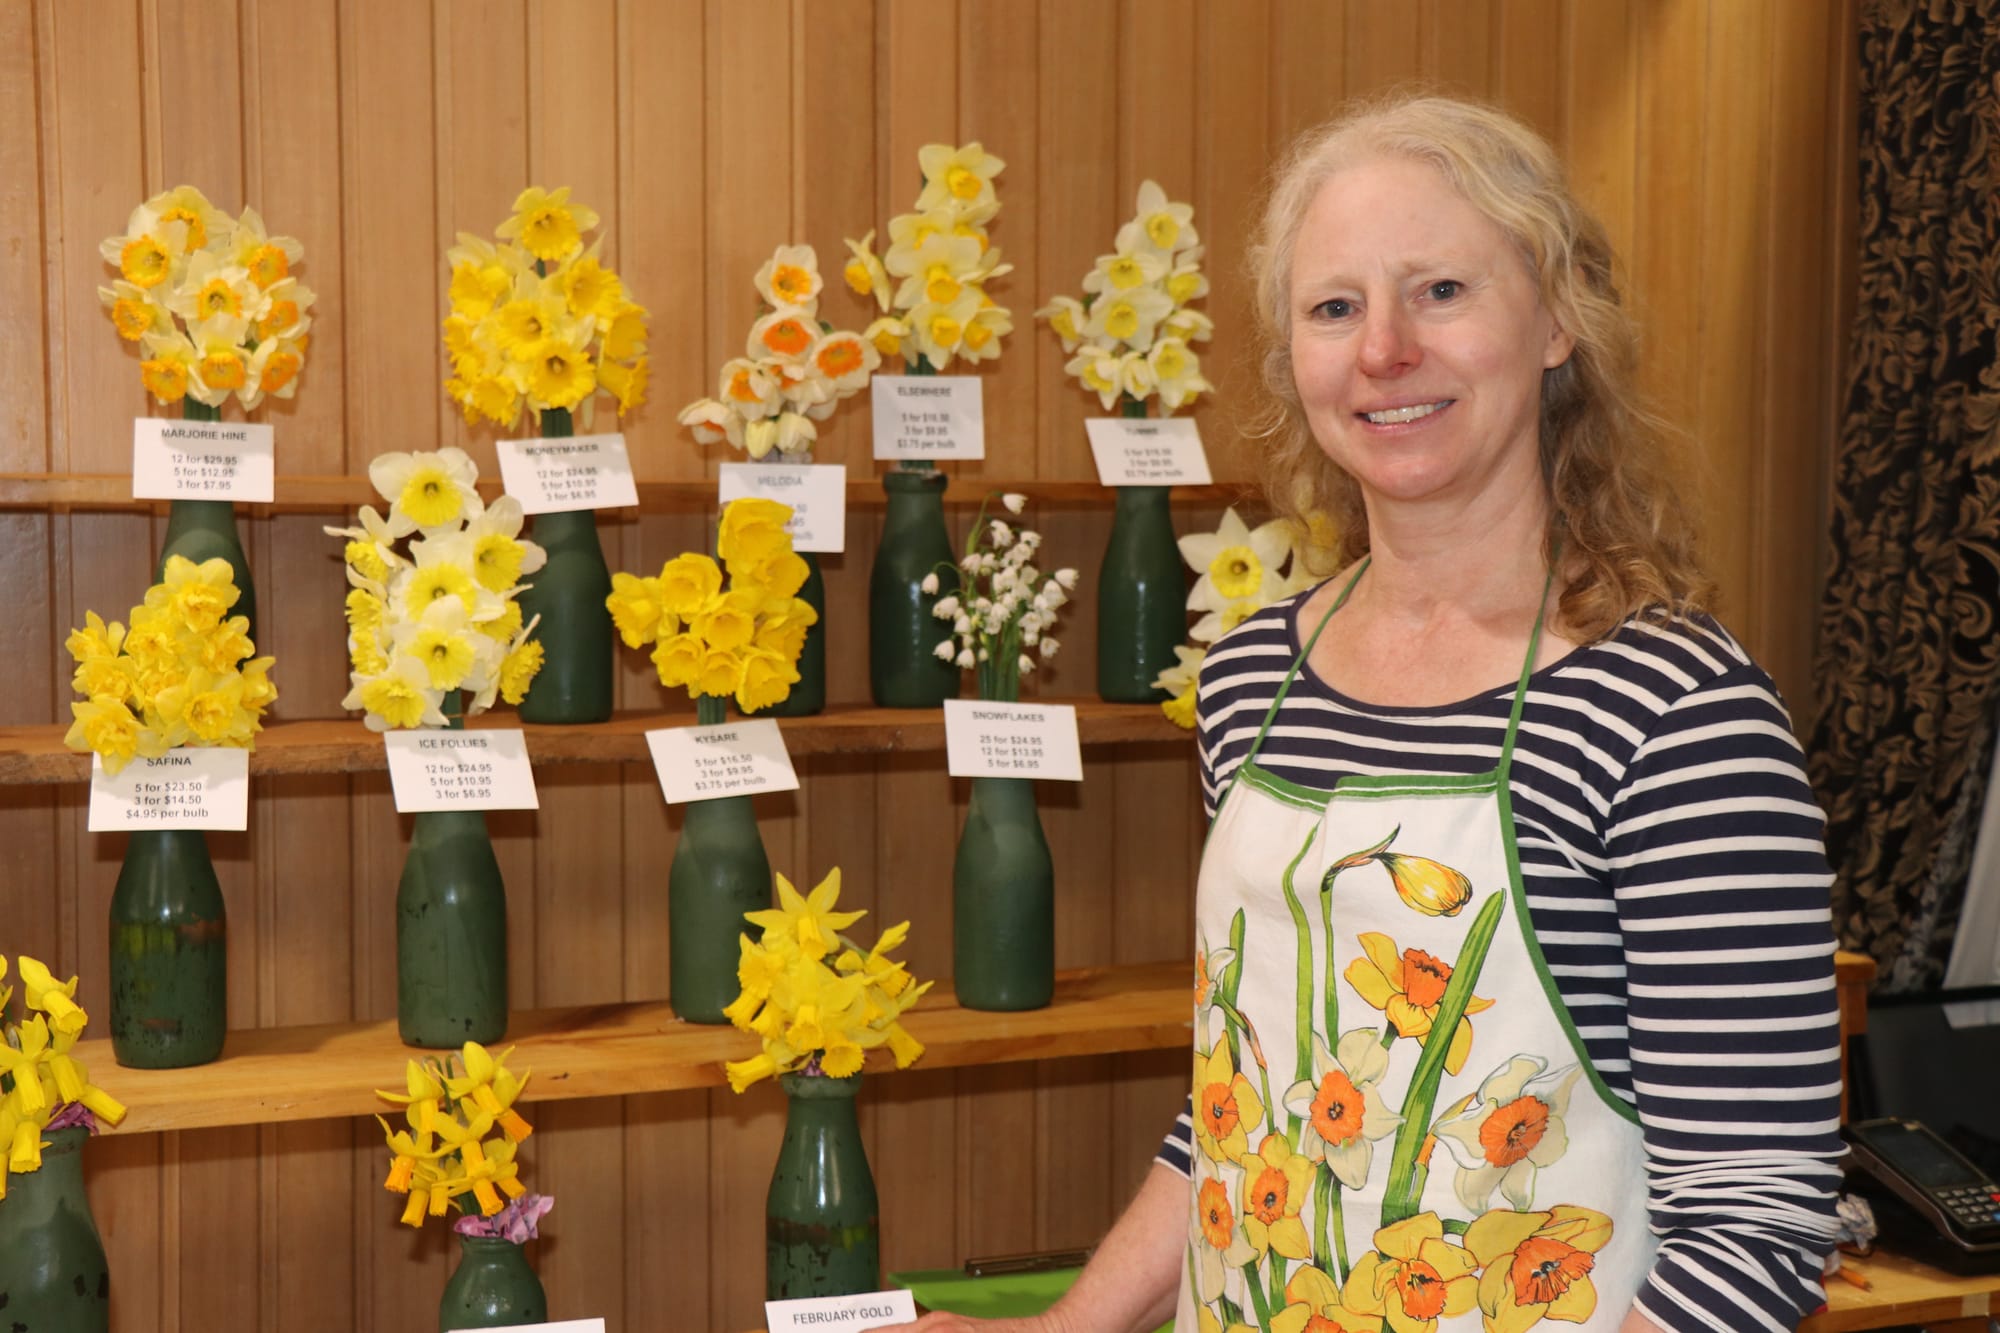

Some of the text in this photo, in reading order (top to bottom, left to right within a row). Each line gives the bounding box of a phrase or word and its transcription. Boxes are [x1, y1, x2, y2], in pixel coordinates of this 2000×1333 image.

[161, 428, 247, 441] MARJORIE HINE
[525, 444, 599, 456] MONEYMAKER
[172, 454, 237, 465] 12 for $29.95
[174, 467, 235, 478] 5 for $12.95
[537, 467, 598, 479] 12 for $24.95
[177, 480, 232, 490] 3 for $7.95
[972, 711, 1045, 722] SNOWFLAKES
[419, 738, 488, 749] ICE FOLLIES
[694, 732, 739, 744] KYSARE
[980, 735, 1043, 745] 25 for $24.95
[981, 747, 1043, 758] 12 for $13.95
[146, 756, 192, 767] SAFINA
[695, 754, 752, 768] 5 for $16.50
[988, 759, 1039, 769] 5 for $6.95
[425, 764, 492, 774] 12 for $24.95
[701, 766, 754, 779] 3 for $9.95
[430, 776, 491, 786] 5 for $10.95
[695, 775, 766, 791] $3.75 per bulb
[135, 782, 202, 793] 5 for $23.50
[435, 789, 491, 799] 3 for $6.95
[134, 795, 202, 806] 3 for $14.50
[126, 808, 209, 820] $4.95 per bulb
[793, 1305, 893, 1325] FEBRUARY GOLD
